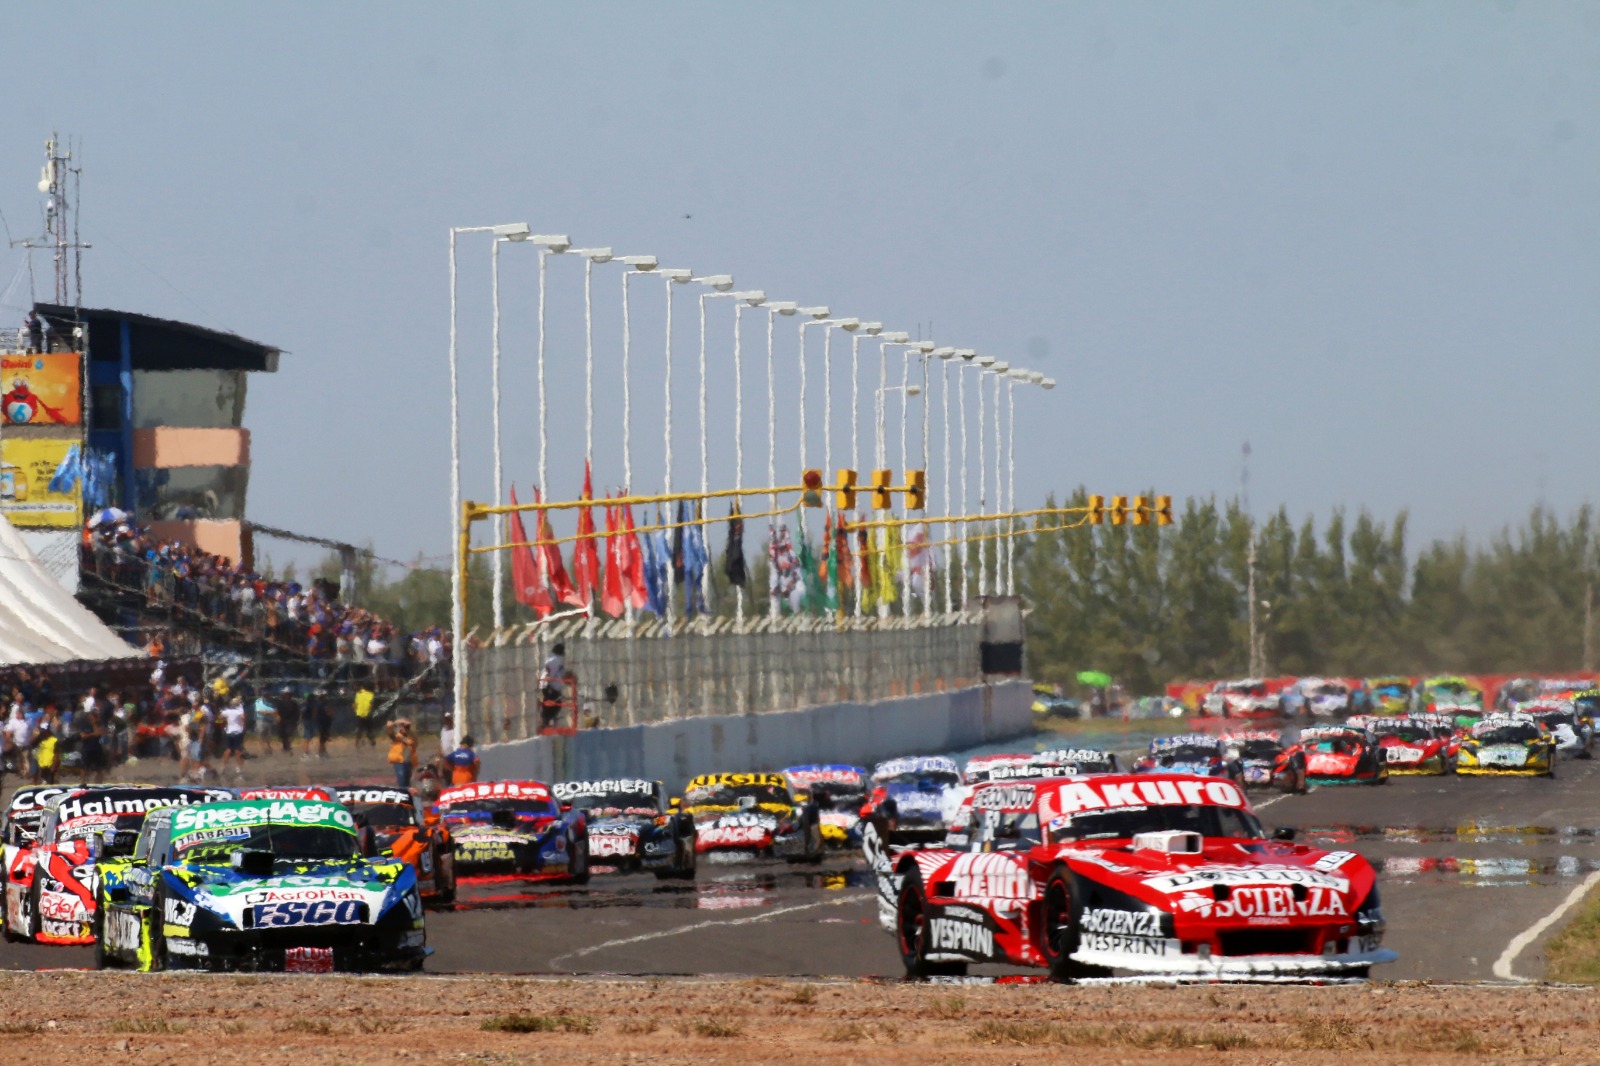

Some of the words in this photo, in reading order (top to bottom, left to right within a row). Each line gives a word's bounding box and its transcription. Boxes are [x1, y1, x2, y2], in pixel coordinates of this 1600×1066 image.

[1059, 781, 1241, 814] Akuro
[174, 801, 354, 830] SpeedAgro
[254, 900, 362, 928] ESCO
[1215, 886, 1349, 918] SCIENZA
[1088, 908, 1164, 936] SCIENZA
[930, 918, 994, 957] VESPRINI
